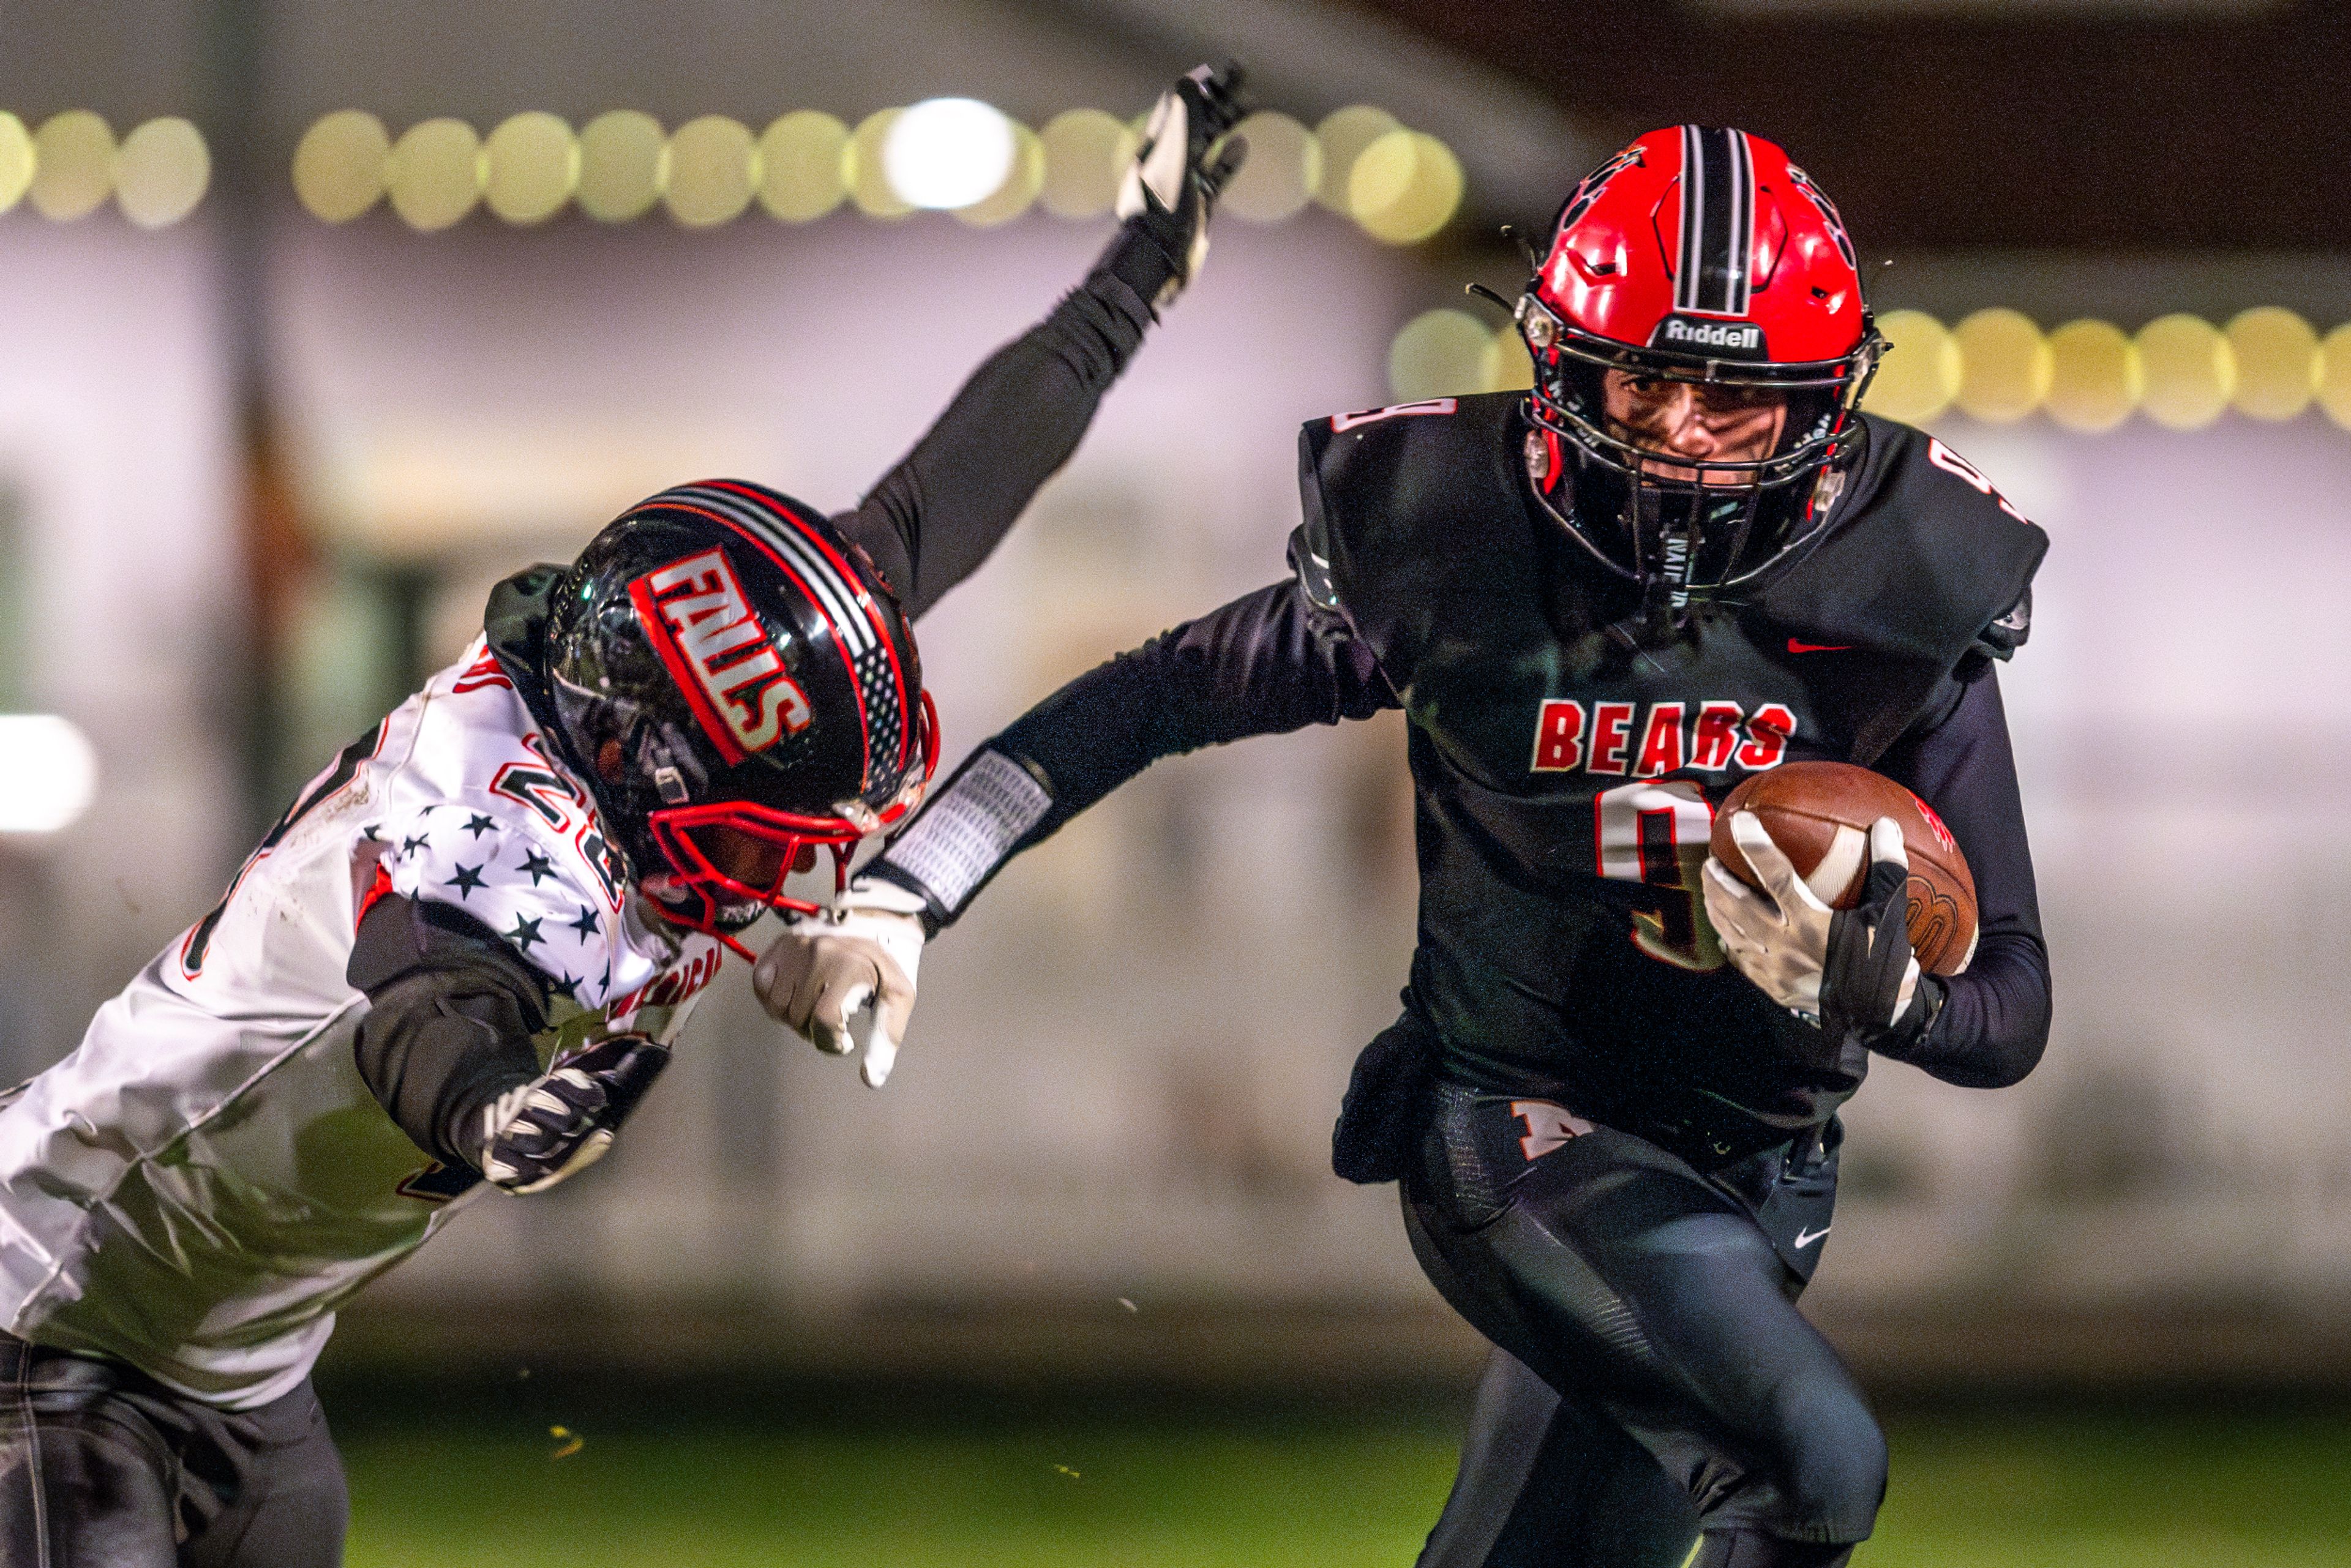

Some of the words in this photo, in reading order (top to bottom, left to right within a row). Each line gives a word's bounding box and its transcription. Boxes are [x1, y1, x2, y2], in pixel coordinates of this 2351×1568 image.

[1665, 319, 1760, 348] Riddell
[648, 544, 810, 753] FALLS
[1531, 698, 1798, 778] BEARS
[1594, 778, 1728, 973] 9
